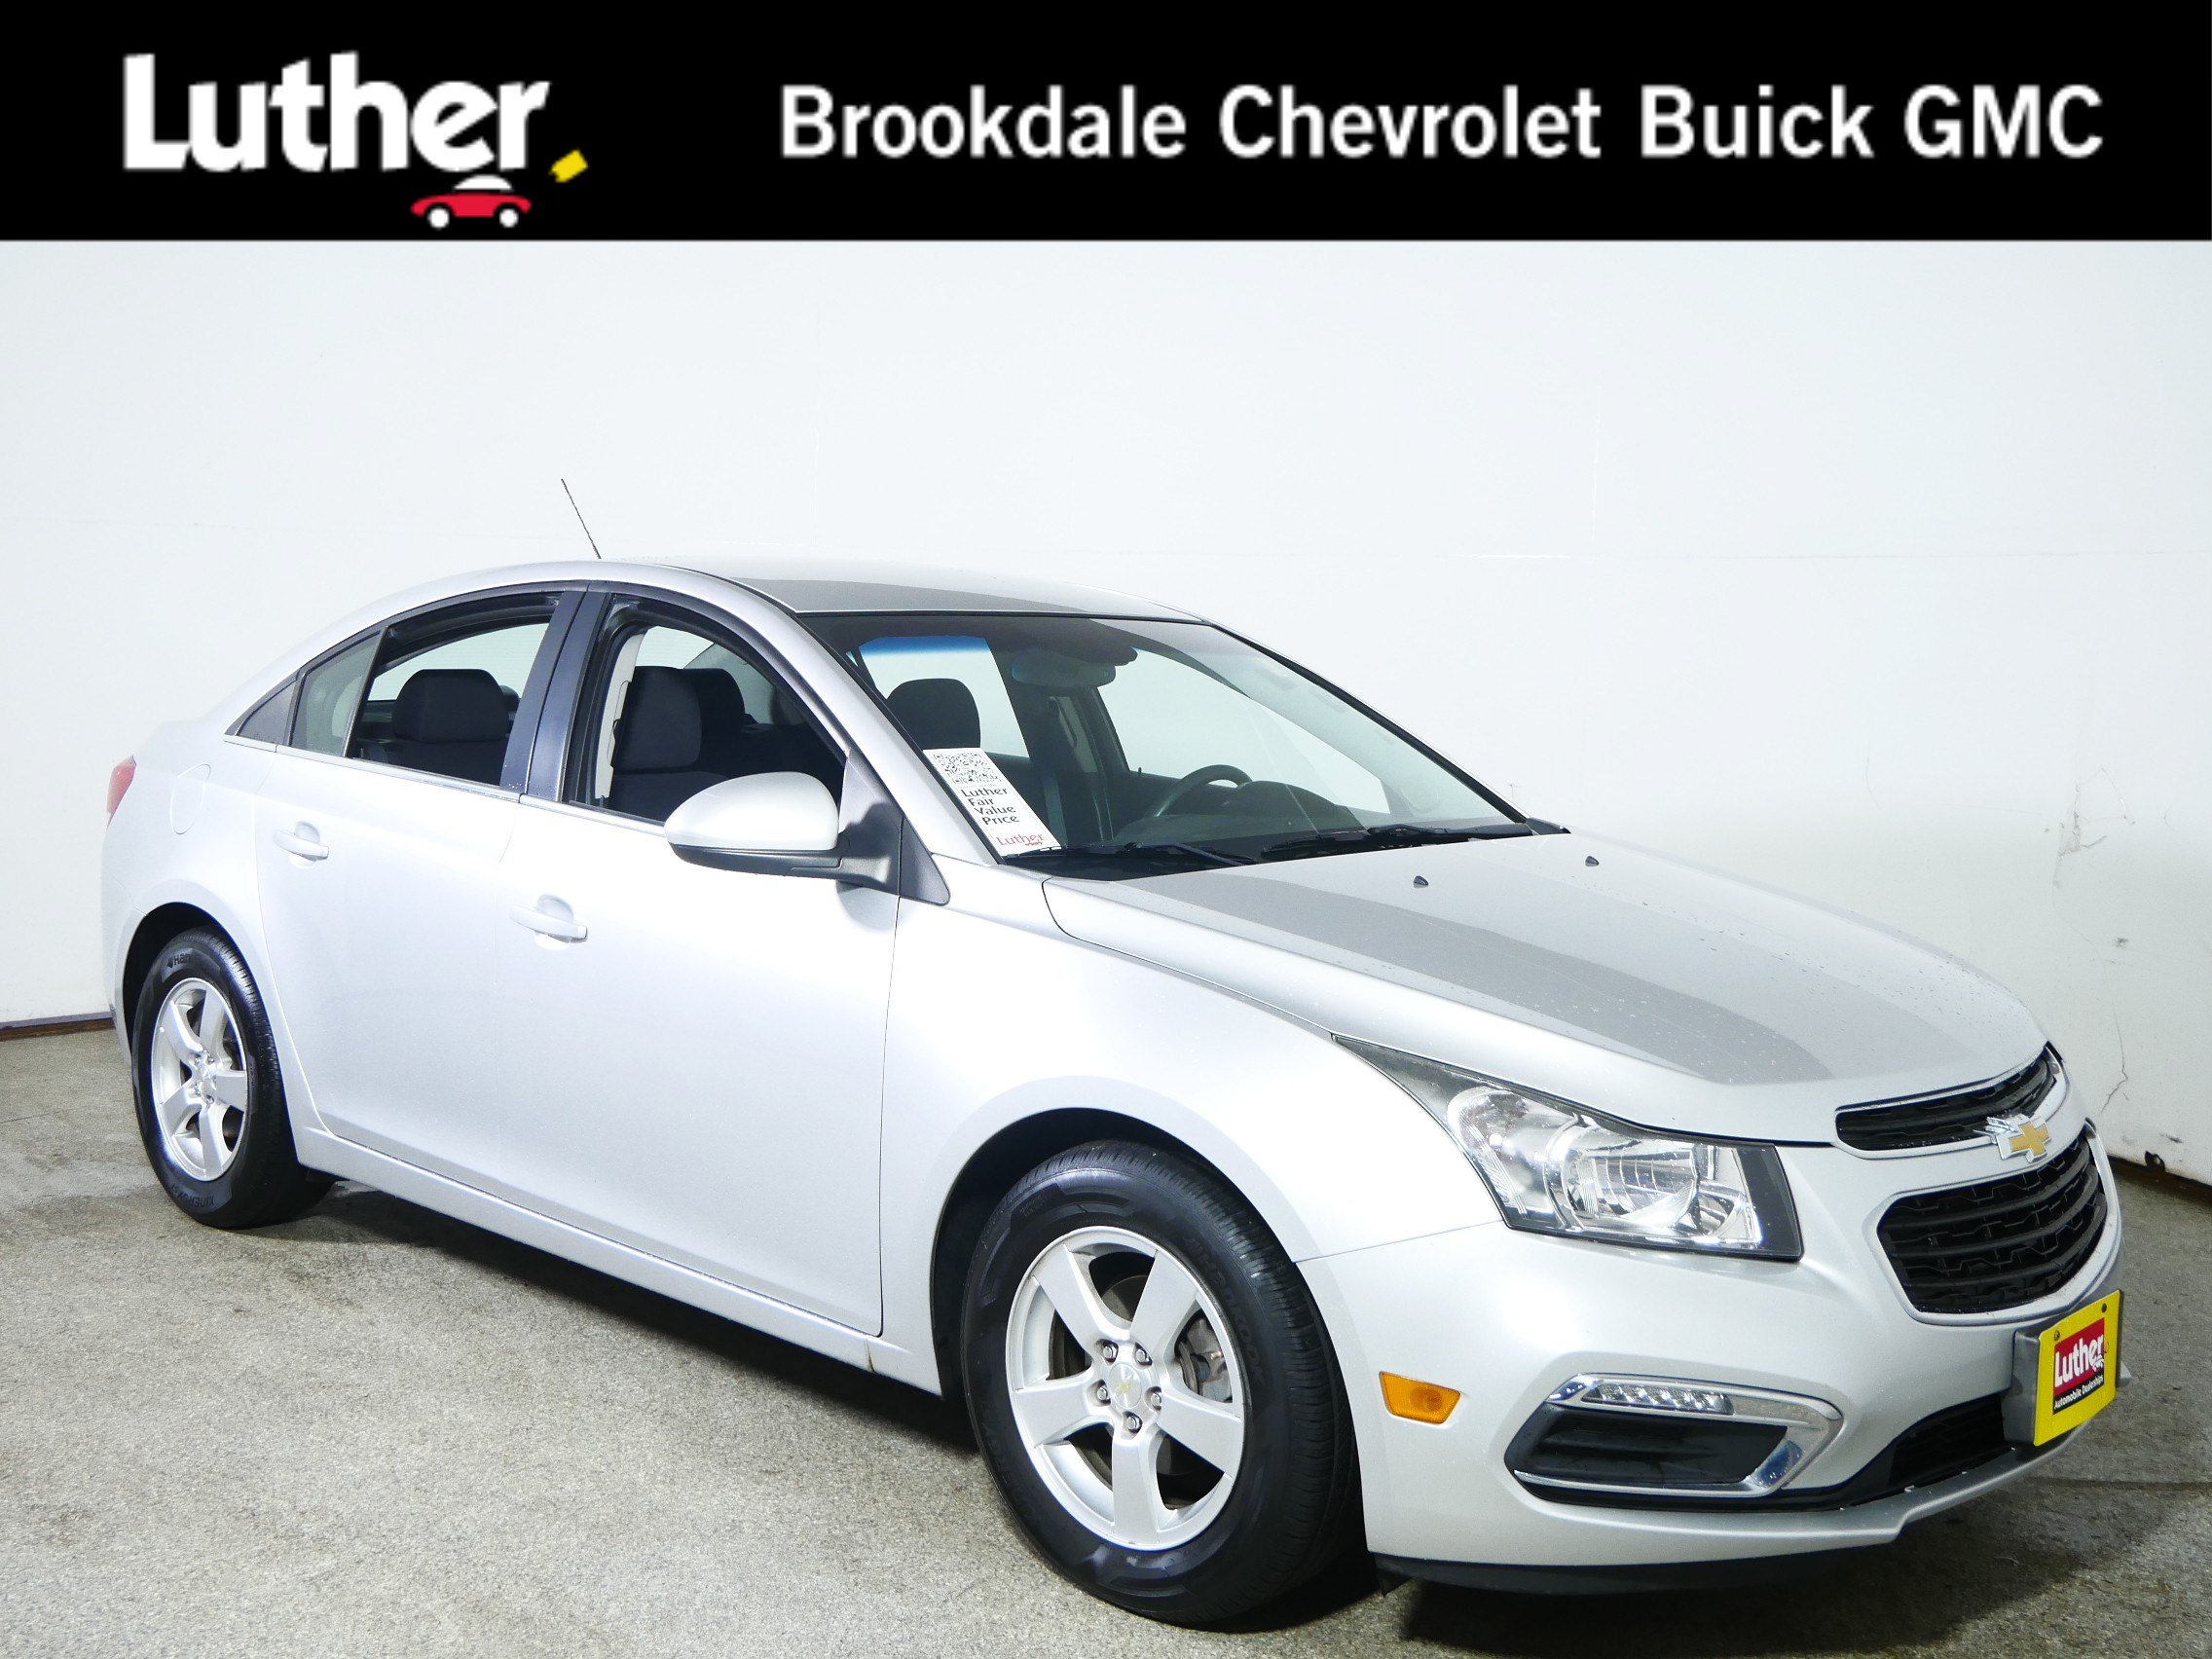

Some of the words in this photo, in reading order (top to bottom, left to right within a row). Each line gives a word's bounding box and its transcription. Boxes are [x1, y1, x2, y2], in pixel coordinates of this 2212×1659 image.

[961, 788, 1008, 797] Luther
[968, 797, 994, 806] Fair
[974, 805, 1016, 815] Value
[981, 816, 1020, 826] Price
[996, 833, 1045, 846] Luther
[2054, 1334, 2104, 1388] Luther
[2054, 1387, 2082, 1410] Automobile
